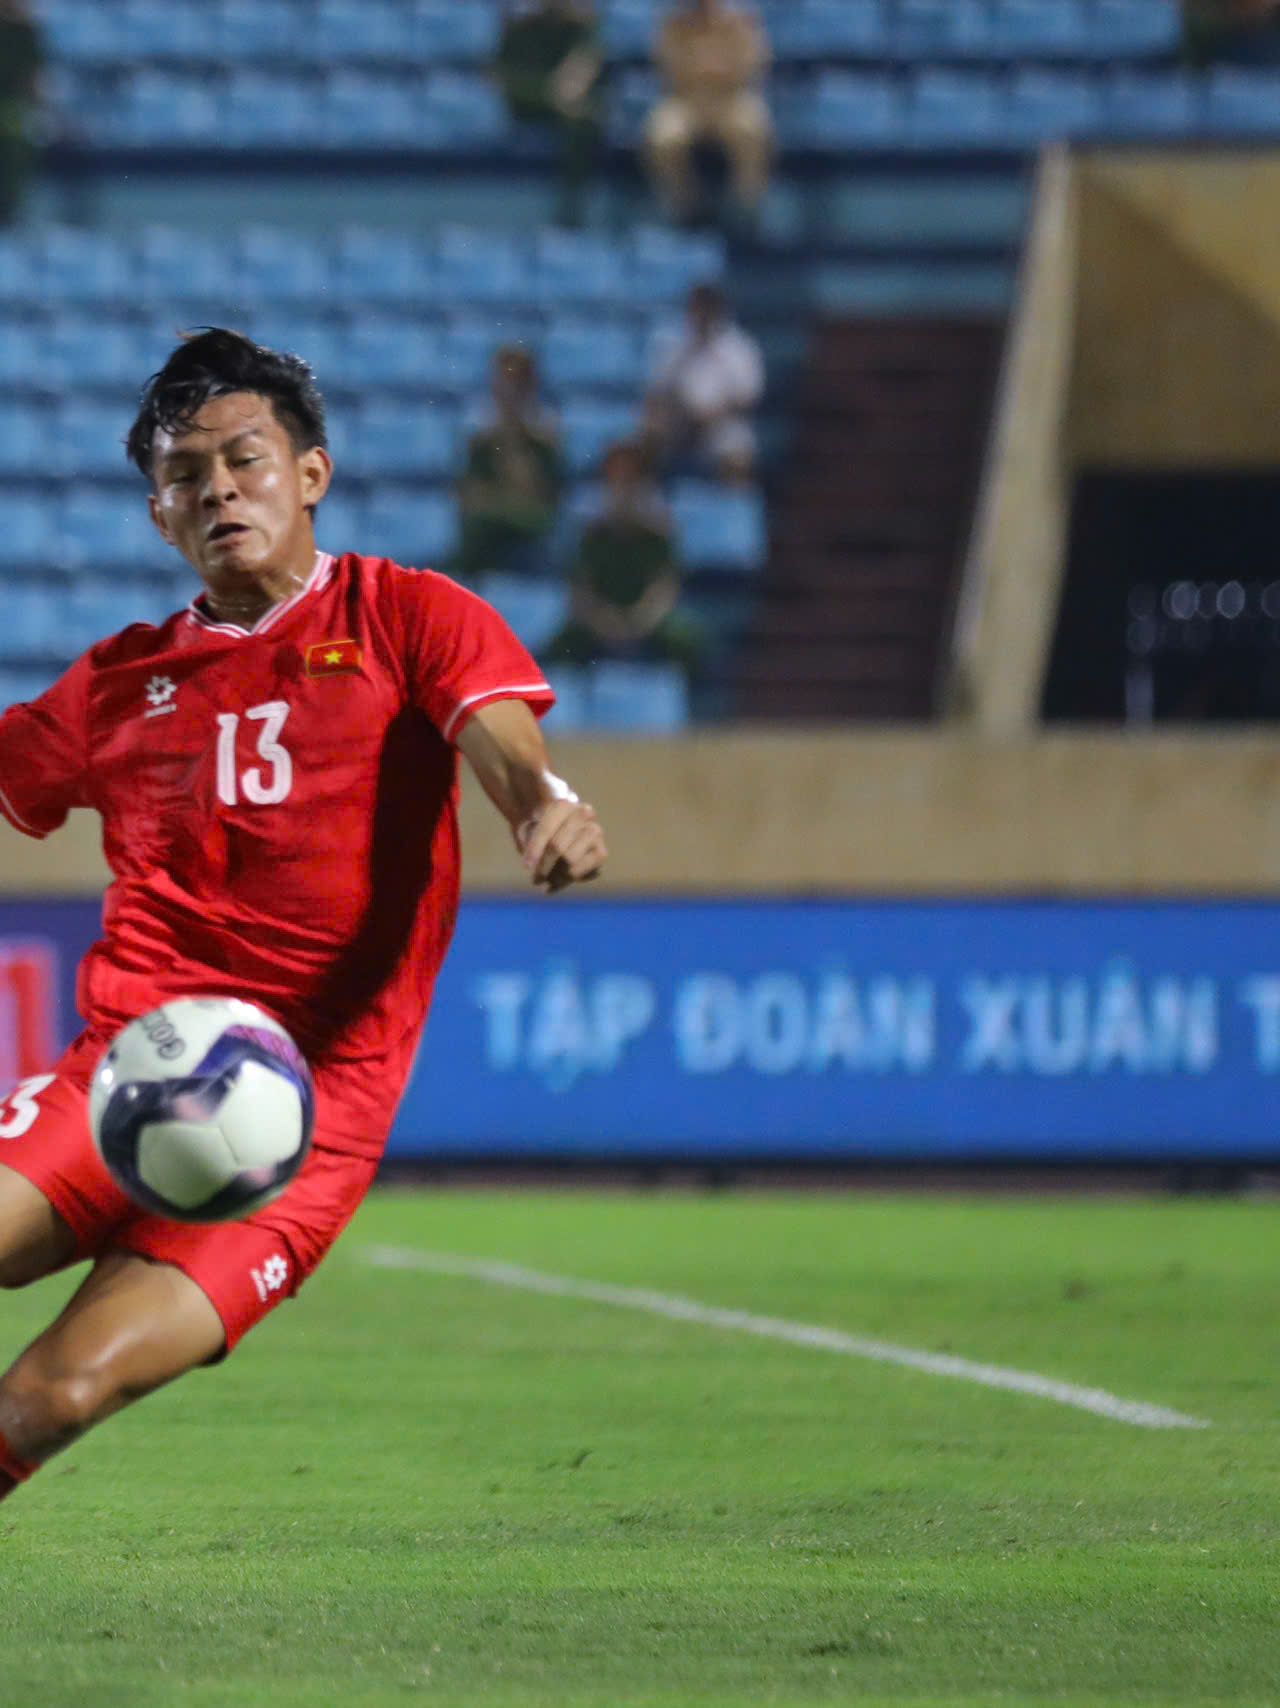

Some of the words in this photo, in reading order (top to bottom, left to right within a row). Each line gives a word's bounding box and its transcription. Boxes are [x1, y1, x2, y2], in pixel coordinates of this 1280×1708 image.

[216, 700, 293, 806] 13
[476, 959, 657, 1091] TẬP
[960, 955, 1217, 1075] XUÂN
